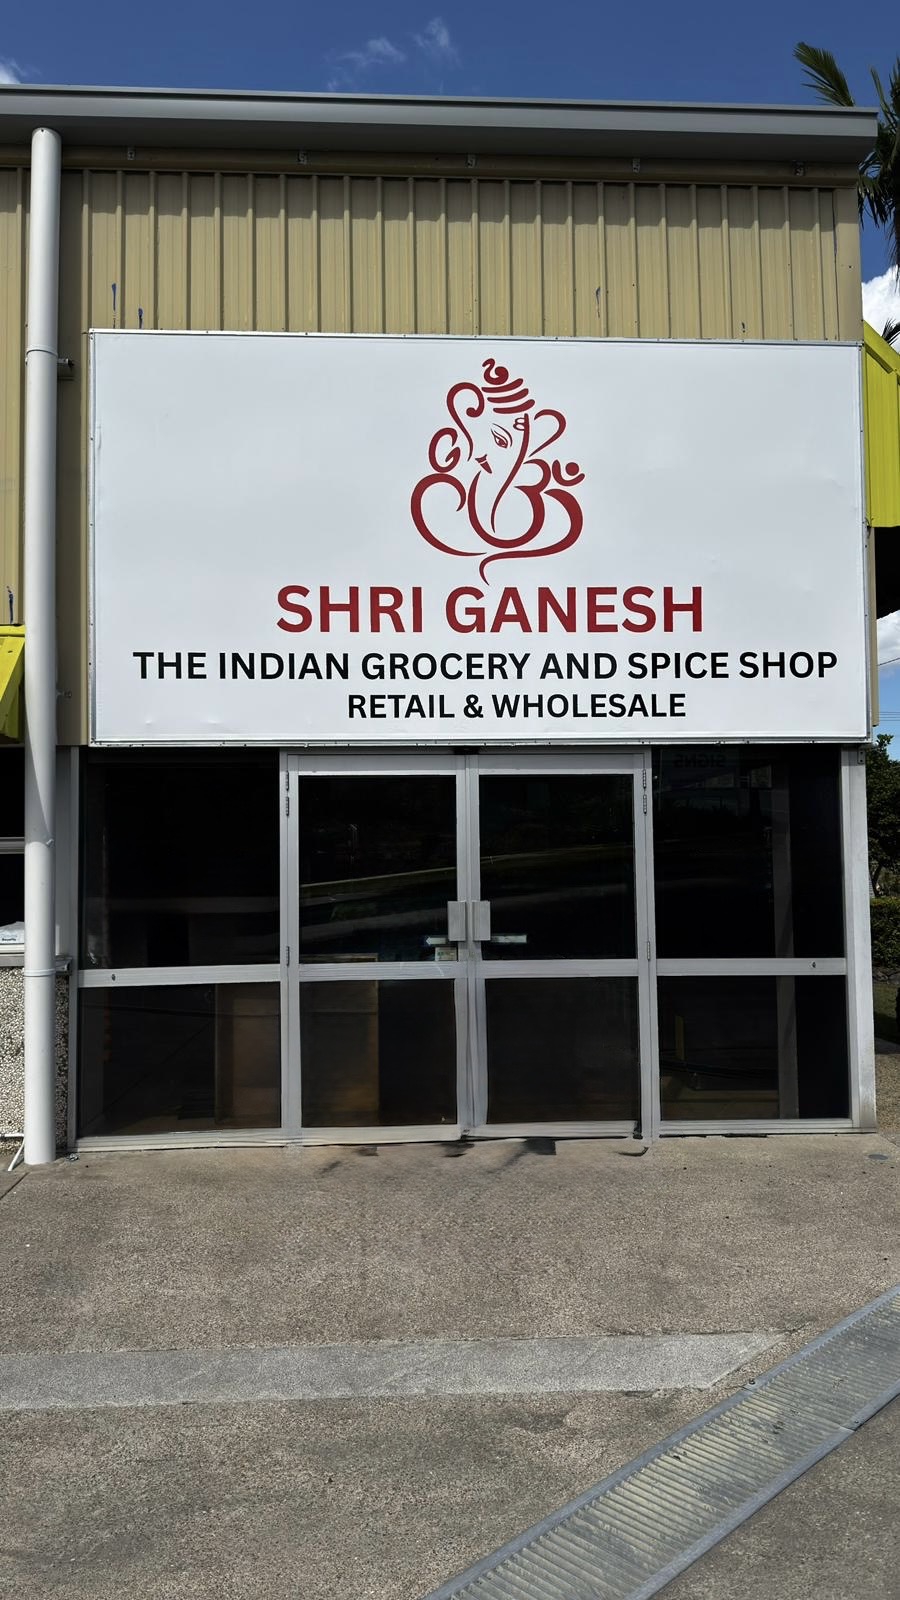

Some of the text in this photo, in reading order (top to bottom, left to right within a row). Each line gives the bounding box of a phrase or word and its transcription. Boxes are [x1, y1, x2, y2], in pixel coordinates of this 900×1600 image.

[277, 585, 702, 633] SHRI GANESH
[133, 651, 837, 680] THE INDIAN GROCERY AND SPICE SHOP
[349, 693, 686, 719] RETAIL & WHOLESALE
